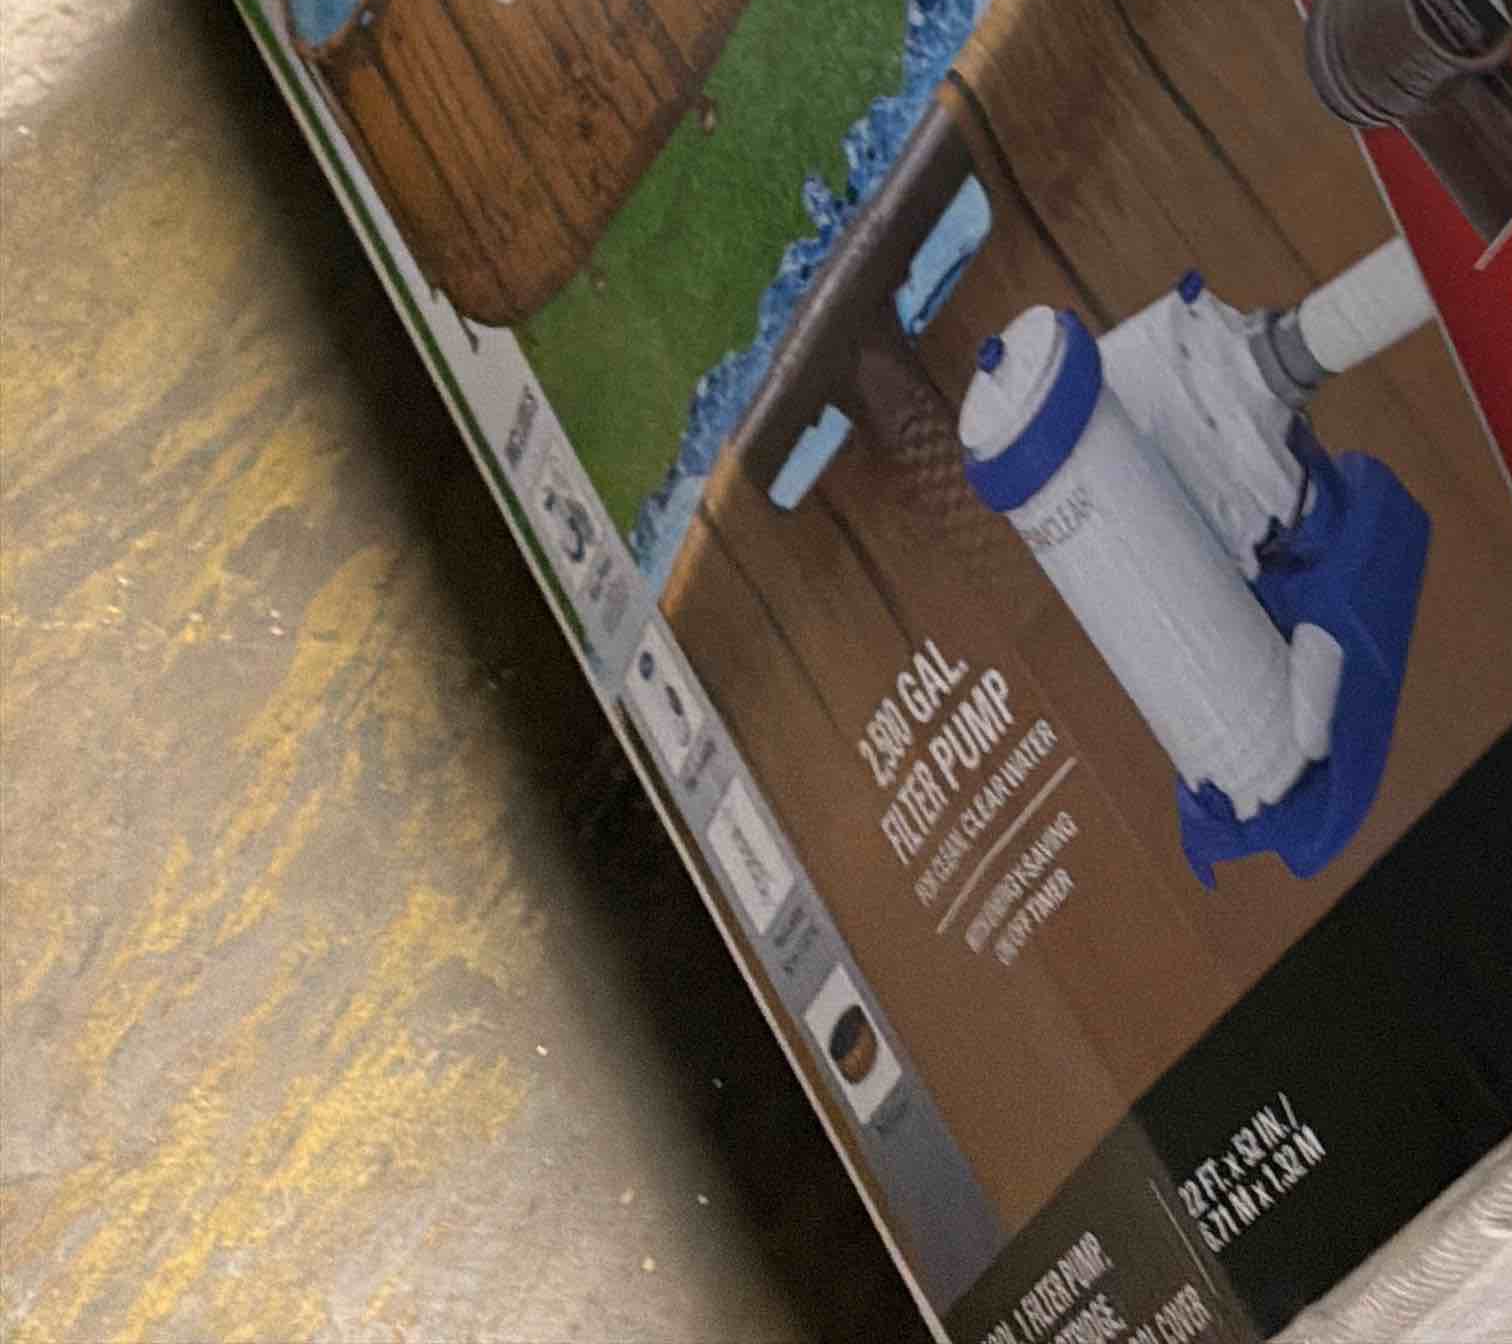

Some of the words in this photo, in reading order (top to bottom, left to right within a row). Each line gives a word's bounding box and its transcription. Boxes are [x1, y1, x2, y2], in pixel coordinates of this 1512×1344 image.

[896, 639, 970, 723] GAL.
[880, 759, 951, 866] FILTER
[928, 668, 1015, 793] PUMP
[1176, 1176, 1209, 1222] 22
[1193, 1155, 1232, 1205] FT.
[1229, 1122, 1265, 1171] 52
[1250, 1098, 1290, 1151] IN.
[1196, 1202, 1241, 1257] 6.71
[1225, 1183, 1262, 1230] M
[1259, 1140, 1307, 1199] 1.32
[1291, 1121, 1328, 1169] M
[1019, 1266, 1075, 1337] FILTER
[1152, 1280, 1215, 1344] COVER
